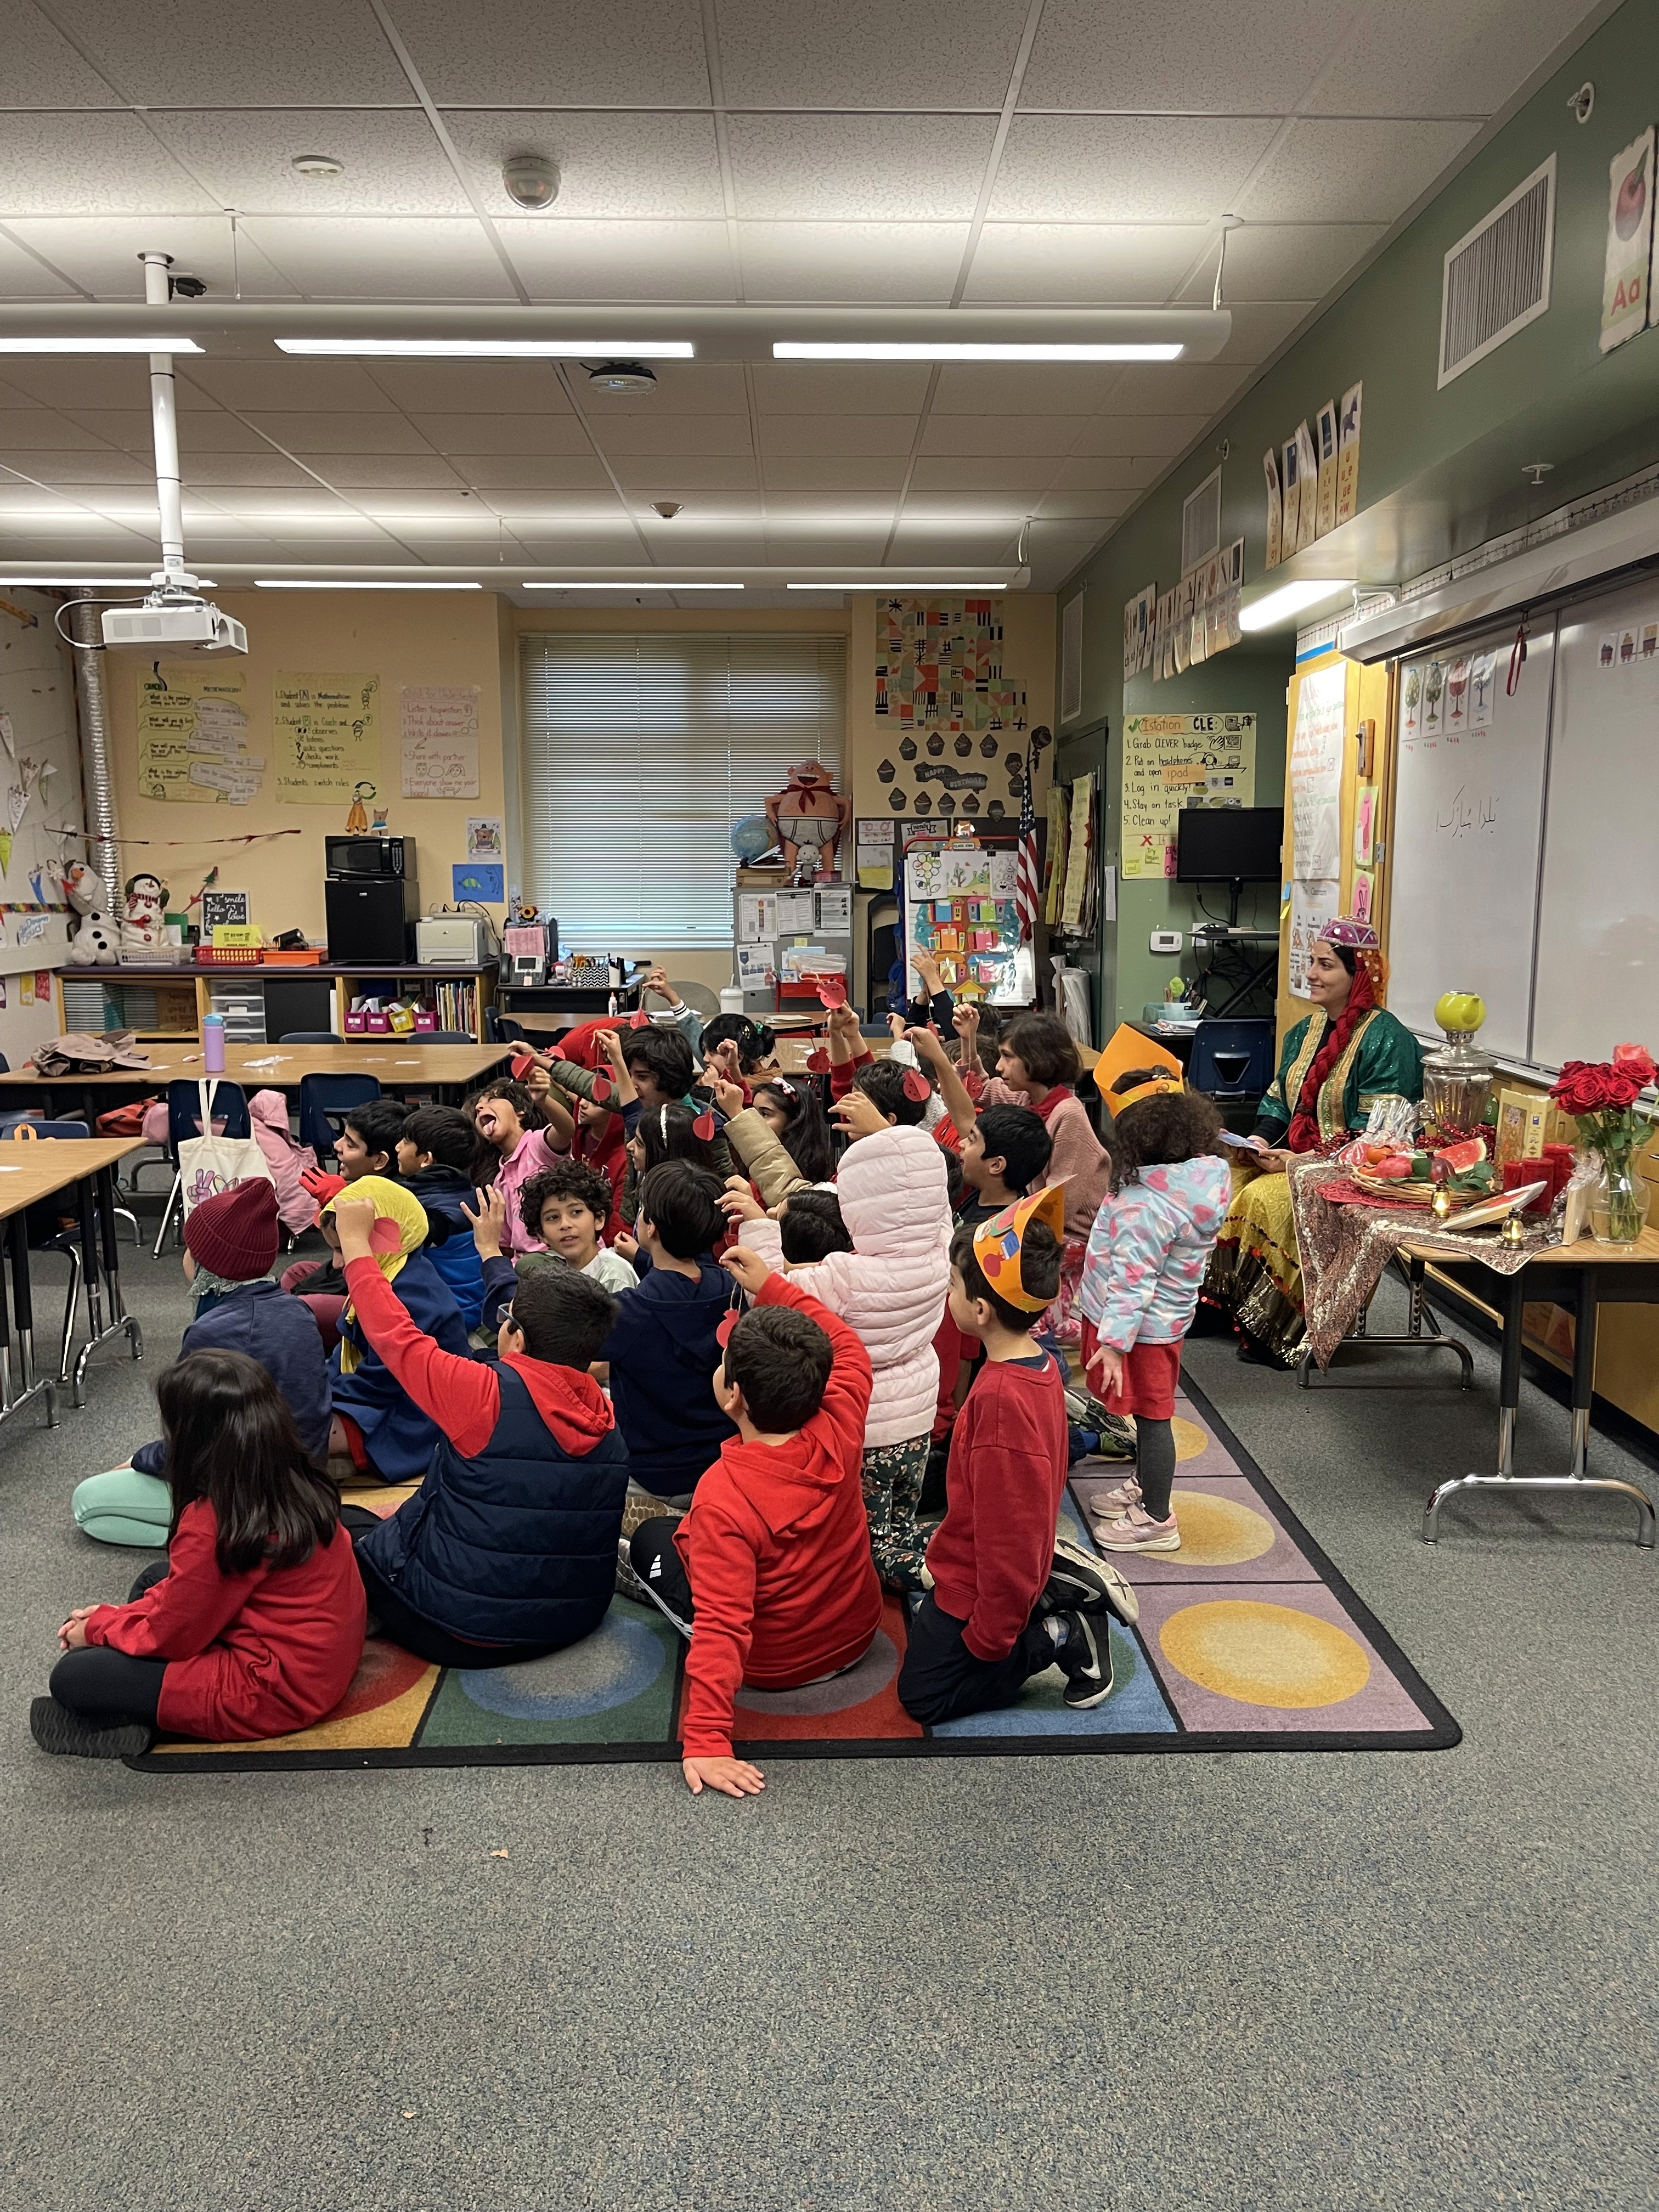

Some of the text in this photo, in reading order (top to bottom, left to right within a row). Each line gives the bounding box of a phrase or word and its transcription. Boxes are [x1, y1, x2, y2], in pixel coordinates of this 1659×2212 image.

[1142, 718, 1181, 732] Istation
[1132, 737, 1152, 749] Grab
[1182, 738, 1204, 751] badge
[1133, 755, 1144, 766] Put
[924, 767, 946, 779] HAPPY
[1133, 767, 1144, 776] and
[1131, 781, 1145, 796] Log
[1150, 782, 1160, 792] in
[1132, 798, 1148, 812] Stay
[1132, 814, 1155, 827] Clean
[207, 903, 225, 913] hello
